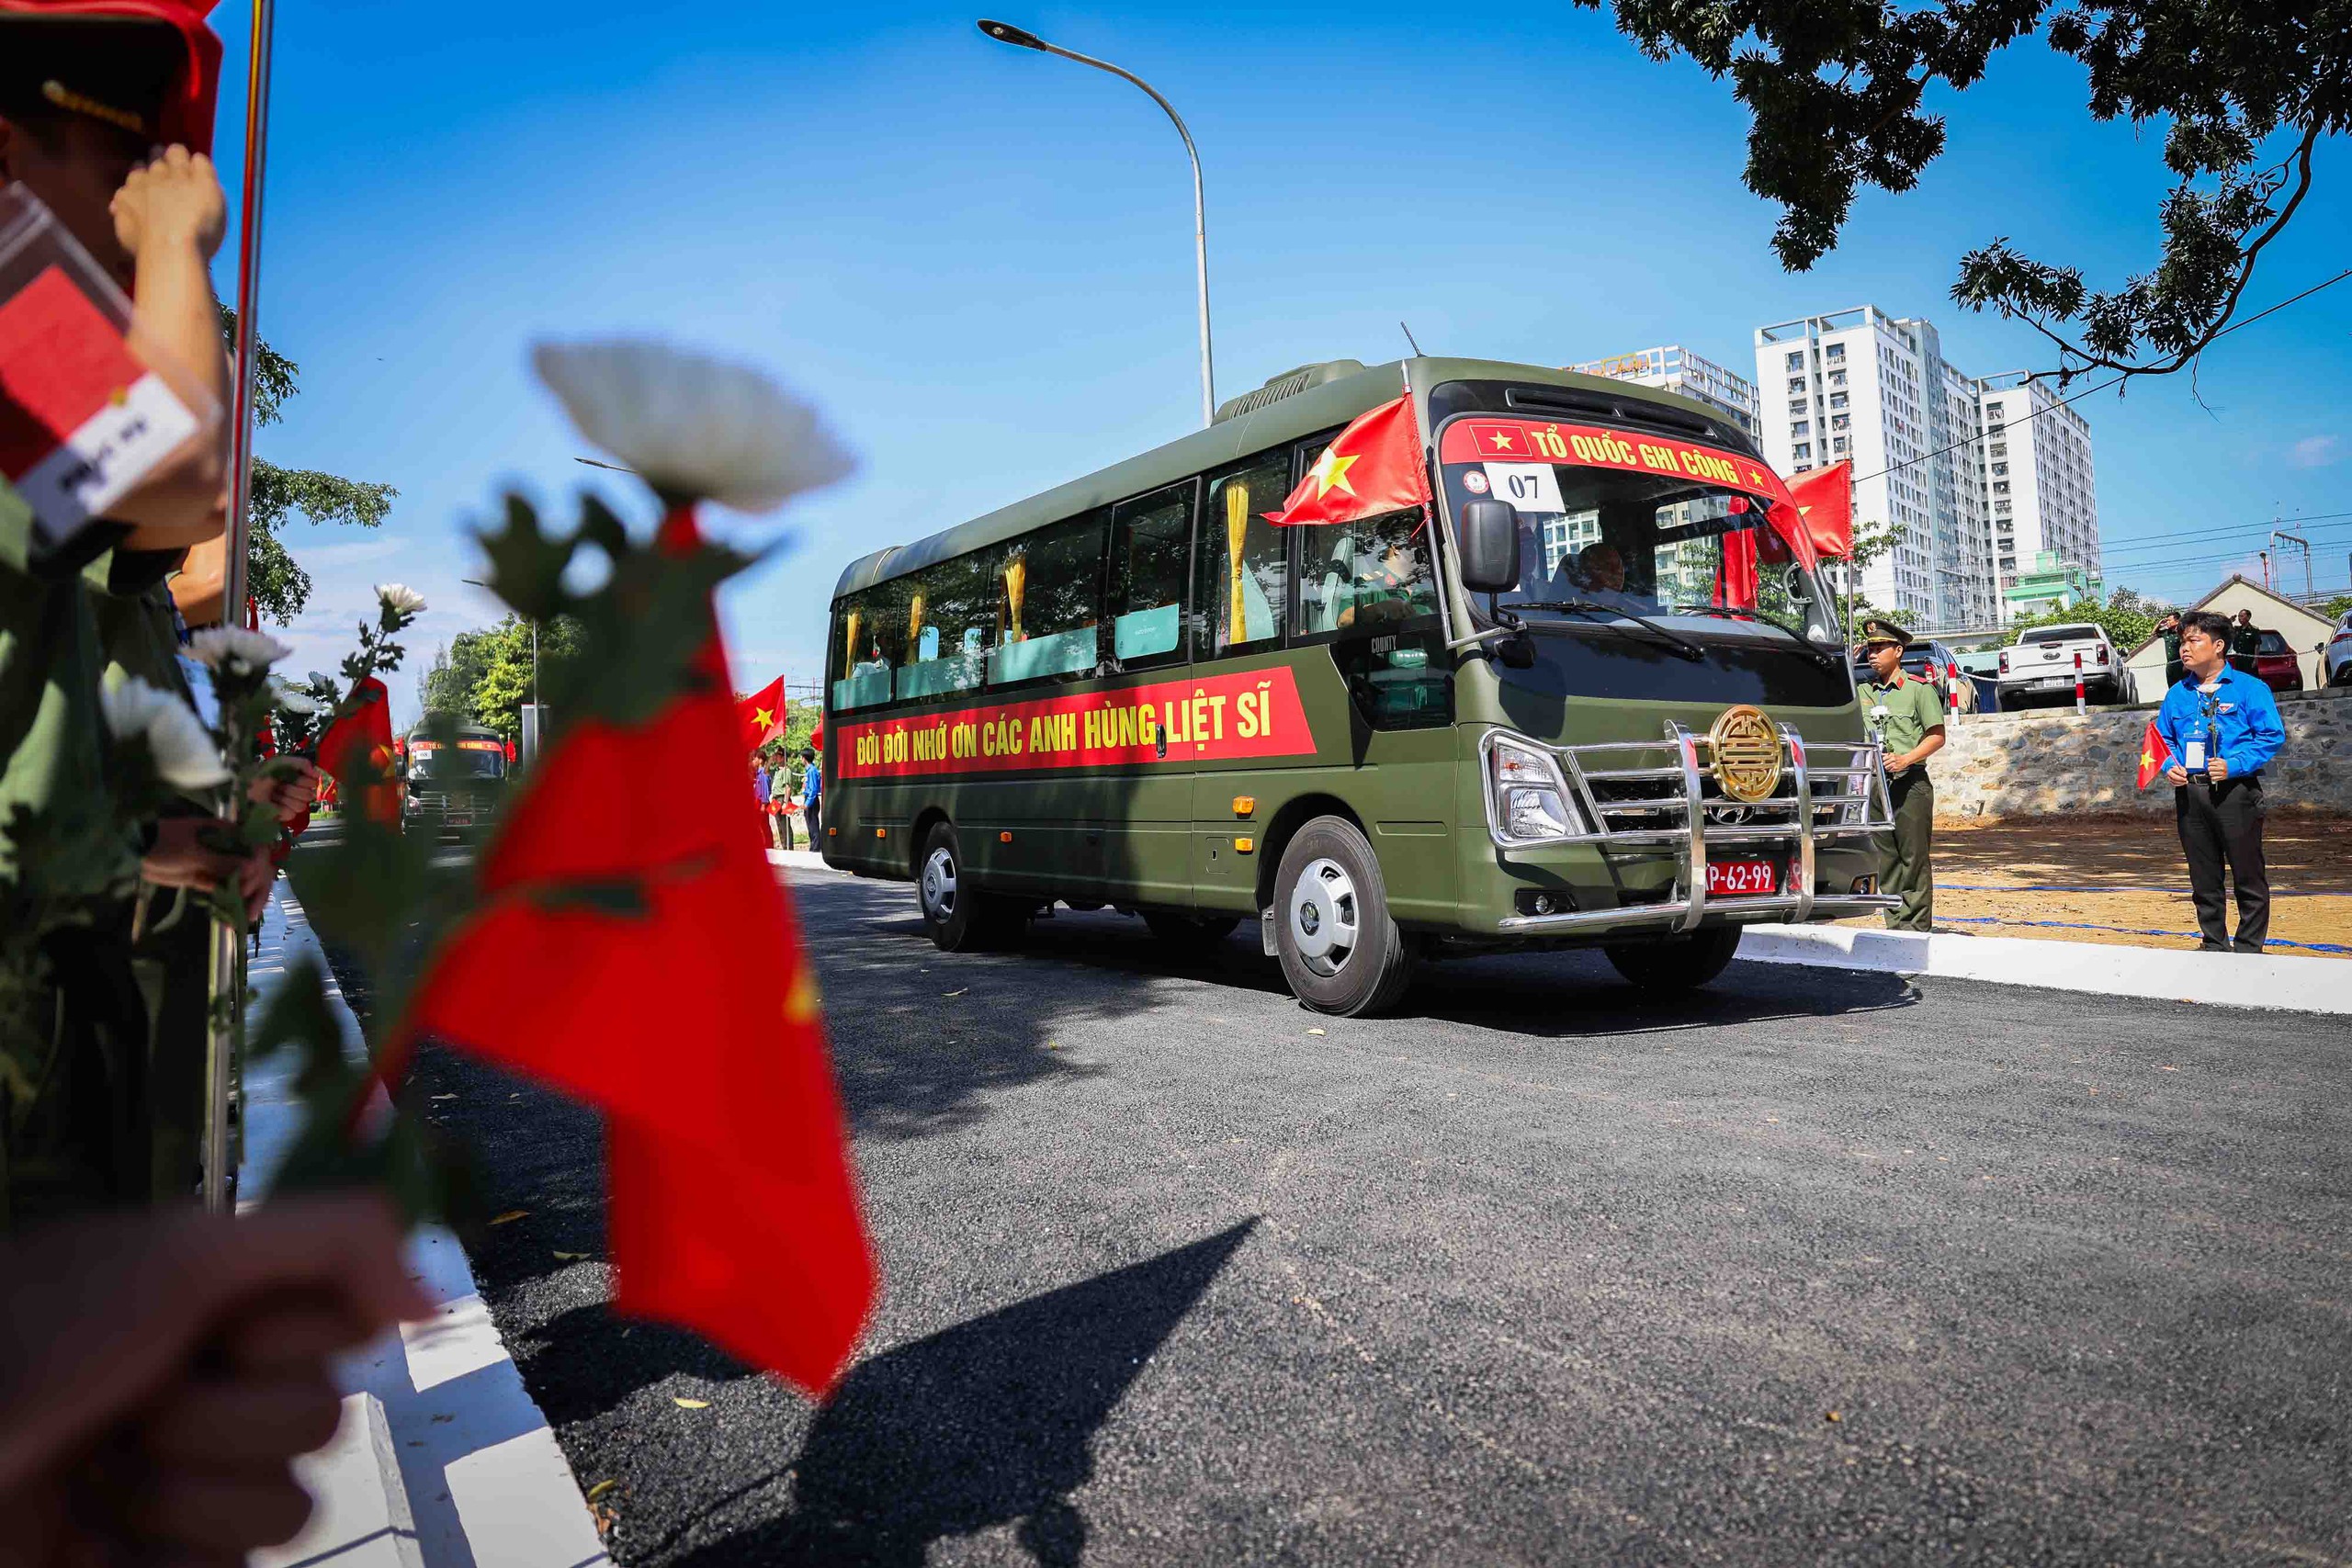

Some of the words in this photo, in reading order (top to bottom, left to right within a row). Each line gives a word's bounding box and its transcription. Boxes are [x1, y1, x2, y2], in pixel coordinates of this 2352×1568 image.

[1531, 423, 1567, 458] TỔ
[1570, 431, 1637, 466] QUỐC
[1638, 444, 1681, 472] GHI
[1679, 448, 1741, 485] CÔNG
[1509, 474, 1538, 499] 07
[1371, 634, 1396, 654] COUNTY
[856, 728, 880, 765] ĐỜI
[883, 725, 909, 763] ĐỜI
[912, 720, 947, 761] NHỚ
[952, 721, 978, 759] ƠN
[982, 713, 1023, 757] CÁC
[1029, 712, 1076, 753] ANH
[1084, 701, 1156, 750] HÙNG
[1164, 688, 1227, 750] LIỆT
[1237, 680, 1272, 738] SĨ
